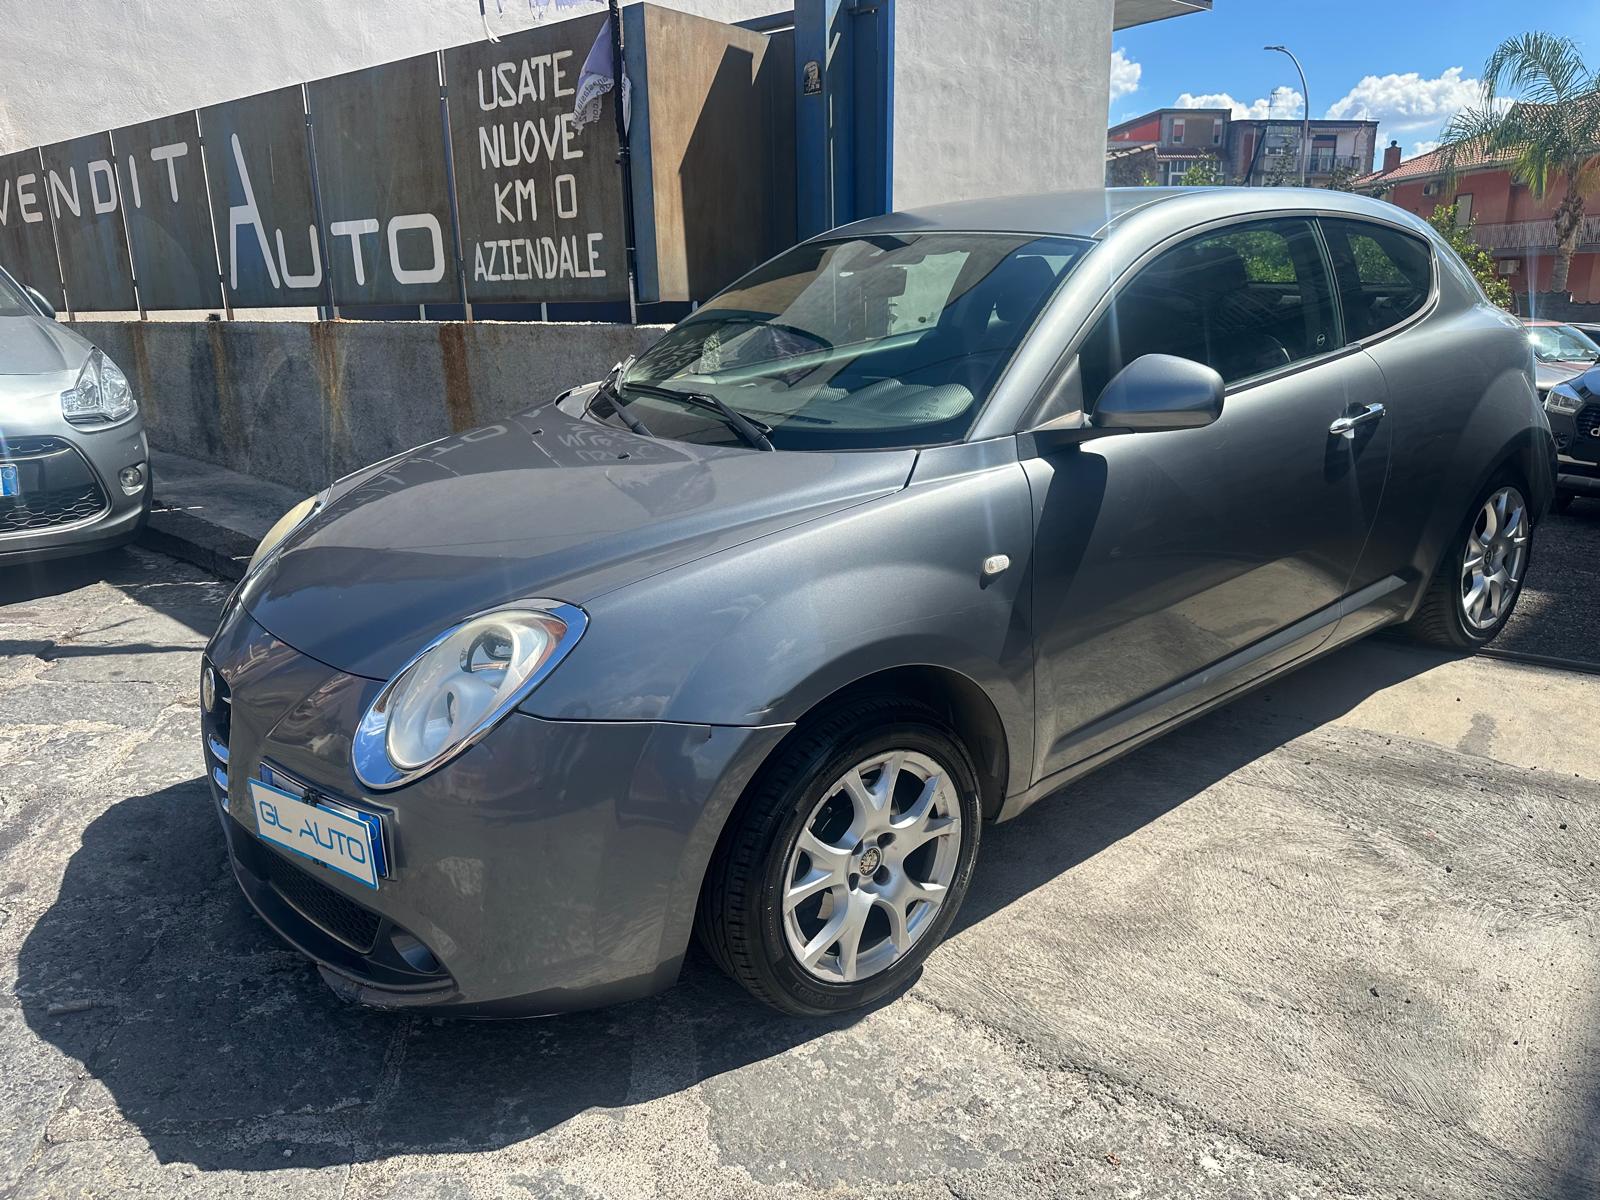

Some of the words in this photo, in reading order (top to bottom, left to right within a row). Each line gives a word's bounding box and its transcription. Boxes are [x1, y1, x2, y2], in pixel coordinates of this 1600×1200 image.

[477, 49, 576, 112] USATE
[478, 112, 584, 170] NUOVE
[494, 178, 538, 224] KM
[474, 232, 607, 282] AZIENDALE
[259, 800, 293, 834] GL
[299, 819, 366, 864] AUTO
